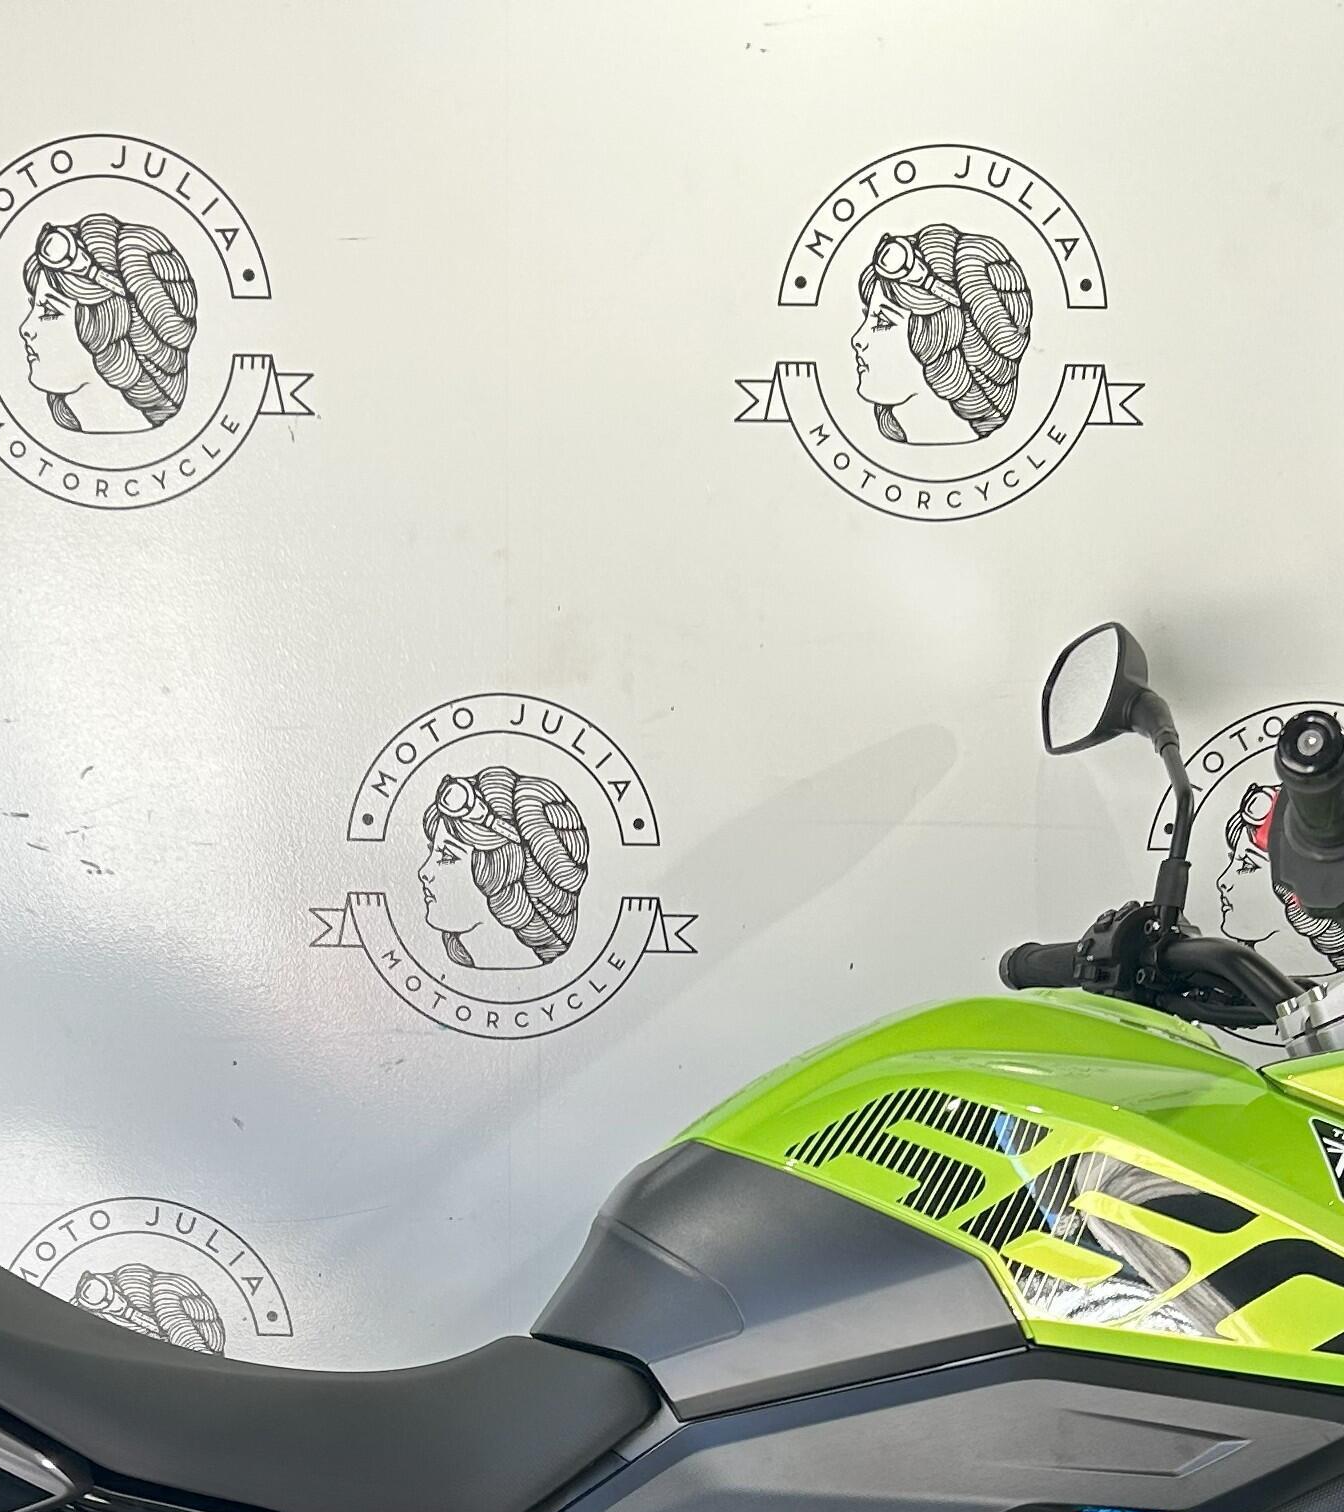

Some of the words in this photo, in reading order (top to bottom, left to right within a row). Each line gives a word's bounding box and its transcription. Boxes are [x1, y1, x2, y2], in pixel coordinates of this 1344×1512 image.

[110, 145, 239, 252] JULIA
[805, 160, 916, 259] MOTO
[954, 155, 1080, 262] JULIA
[808, 423, 1067, 510] MOTORCYCLE
[370, 706, 474, 798] MOTO
[509, 703, 631, 802] JULIA
[1190, 716, 1285, 793] OTO
[381, 949, 626, 1029] MOTORCYCLE
[144, 1206, 265, 1297] JULIA
